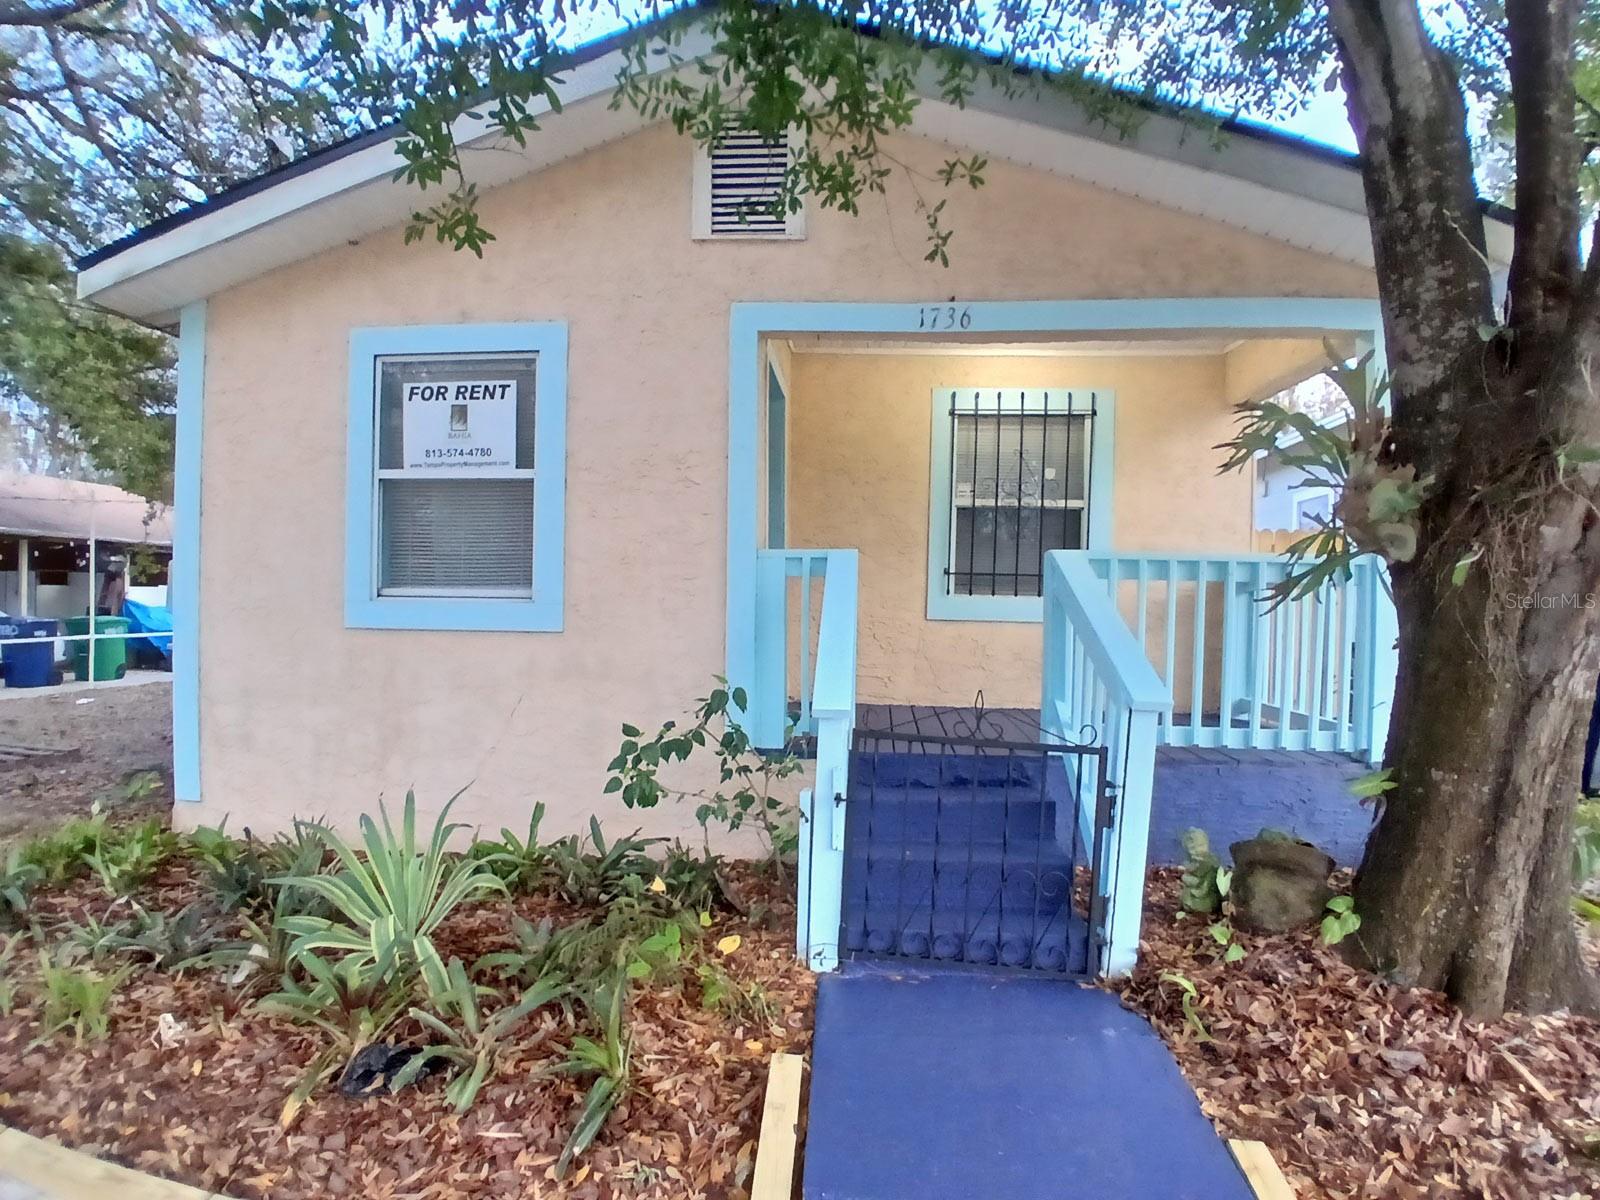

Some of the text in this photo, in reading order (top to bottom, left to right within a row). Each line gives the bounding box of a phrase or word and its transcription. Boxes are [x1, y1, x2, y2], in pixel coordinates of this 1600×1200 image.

[919, 306, 971, 329] 1736
[408, 384, 511, 401] FOR RENT
[425, 448, 492, 458] 813-574-4780
